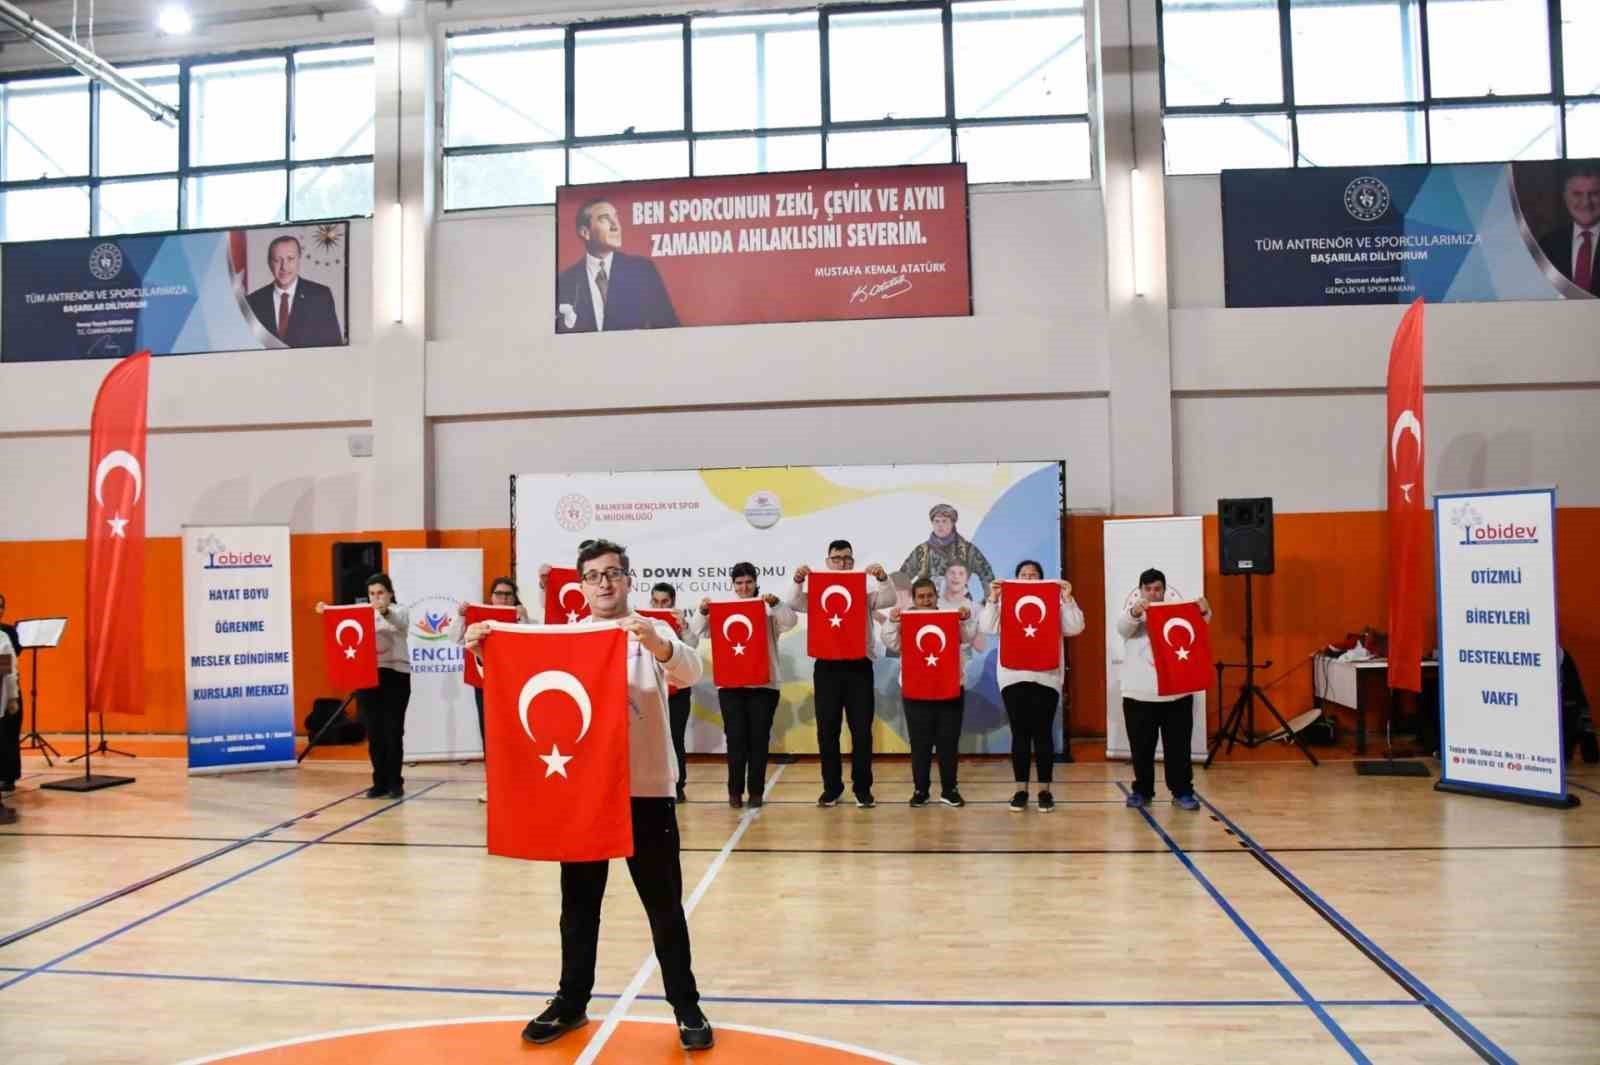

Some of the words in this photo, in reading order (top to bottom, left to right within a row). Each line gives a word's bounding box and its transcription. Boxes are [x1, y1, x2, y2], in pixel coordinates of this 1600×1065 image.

[632, 201, 664, 225] BEN
[669, 194, 770, 223] SPORCUNUN
[776, 185, 819, 220] ZEKİ,
[824, 182, 873, 221] ÇEVİK
[877, 188, 898, 212] VE
[904, 186, 944, 211] AYNI
[651, 230, 733, 256] ZAMANDA
[738, 224, 842, 251] AHLAKLISINI
[848, 213, 927, 247] SEVERİM.
[1255, 238, 1283, 251] TÜM
[1286, 236, 1353, 250] ANTRENÖR
[1356, 237, 1371, 248] VE
[1375, 233, 1482, 247] SPORCULARIMIZA
[1311, 253, 1368, 265] BAŞARILAR
[1370, 250, 1428, 261] DİLİYORUM
[815, 266, 862, 277] MUSTAFA
[864, 264, 898, 274] KEMAL
[901, 261, 946, 273] ATATÜRK
[25, 292, 45, 304] TÜM
[46, 288, 94, 302] ANTRENÖR
[96, 290, 107, 300] VE
[643, 567, 692, 578] DOWN
[1471, 567, 1521, 585] OTİZMLİ
[209, 588, 240, 601] HAYAT
[243, 587, 269, 600] BOYU
[1466, 606, 1530, 625] BİREYLERİ
[215, 619, 264, 634] ÖĞRENME
[191, 655, 231, 668] MESLEK
[234, 651, 289, 666] EDİNDİRME
[1459, 649, 1541, 667] DESTEKLEME
[193, 686, 243, 701] KURSLARI
[246, 684, 289, 698] MERKEZİ
[1482, 690, 1518, 707] VAKFI
